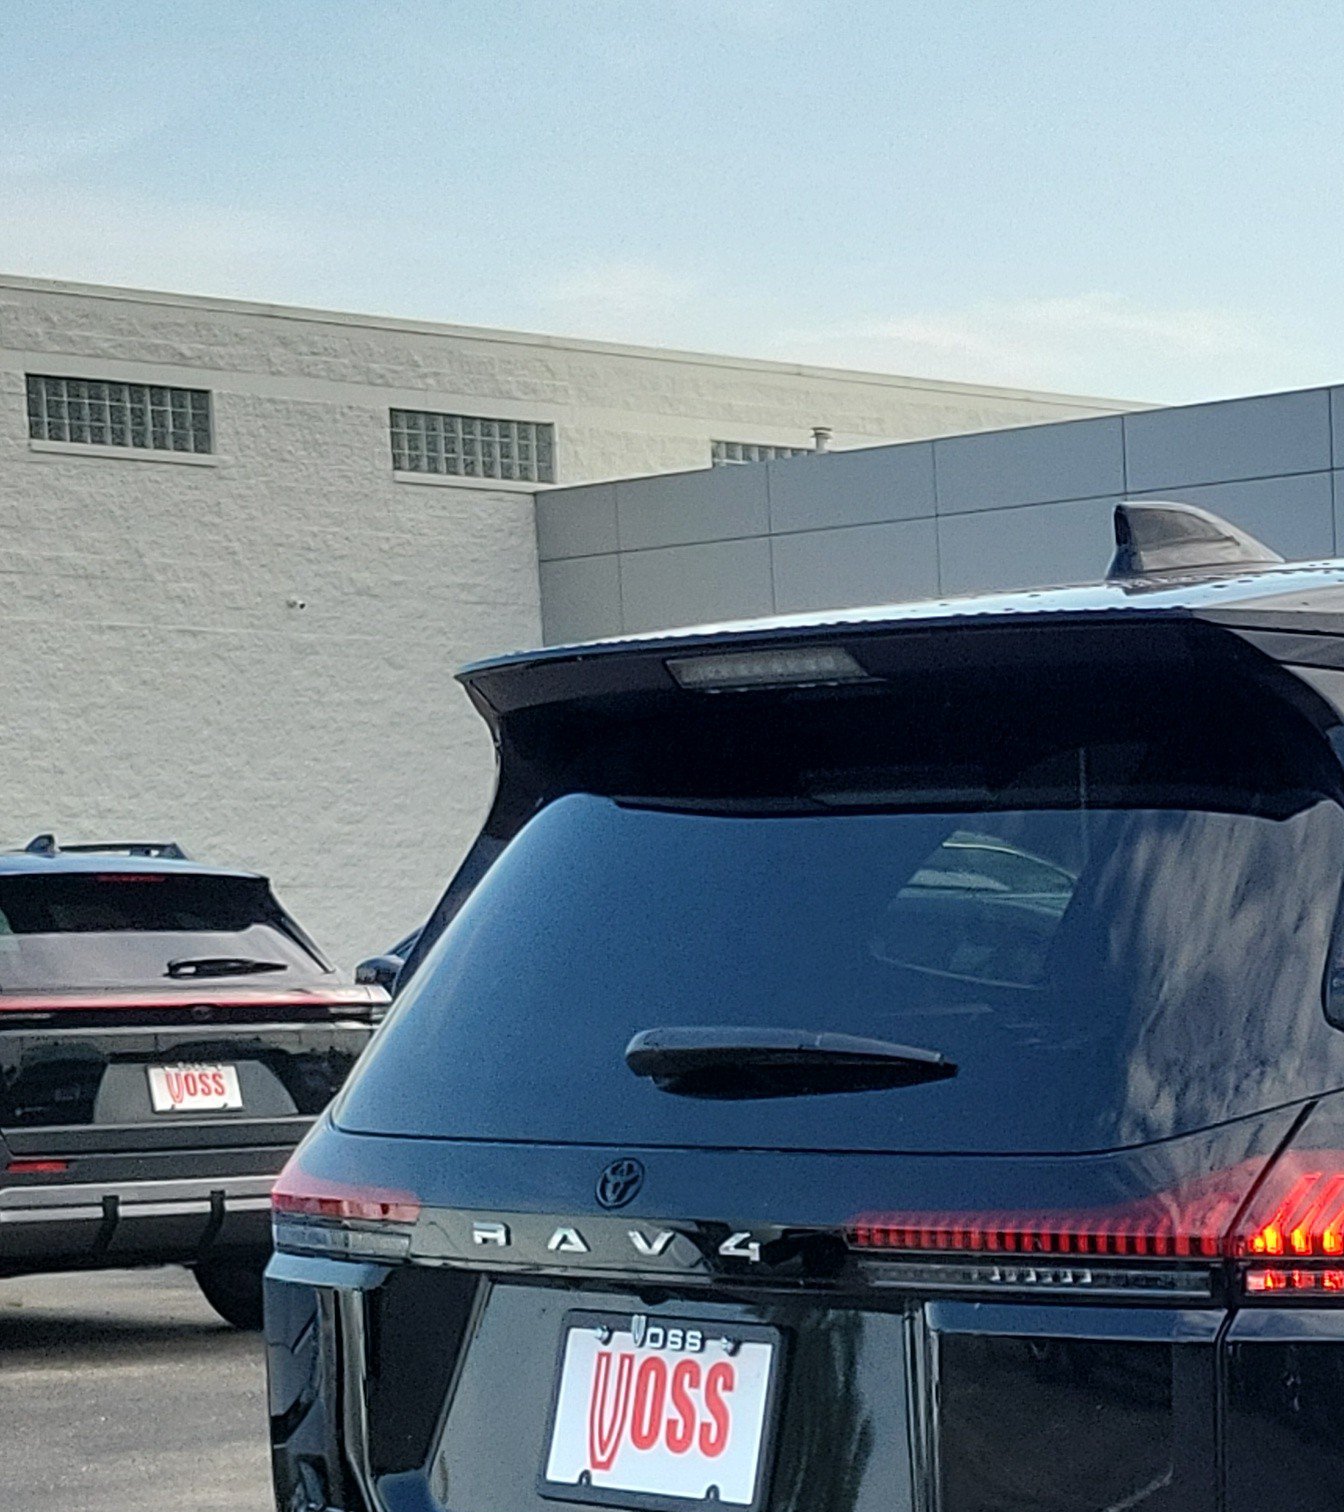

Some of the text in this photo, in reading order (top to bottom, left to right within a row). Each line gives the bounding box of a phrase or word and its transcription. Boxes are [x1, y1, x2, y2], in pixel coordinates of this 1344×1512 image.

[165, 1070, 226, 1104] VOSS
[471, 1220, 763, 1265] RAV4
[630, 1314, 703, 1351] VOSS
[587, 1350, 737, 1472] VOSS
